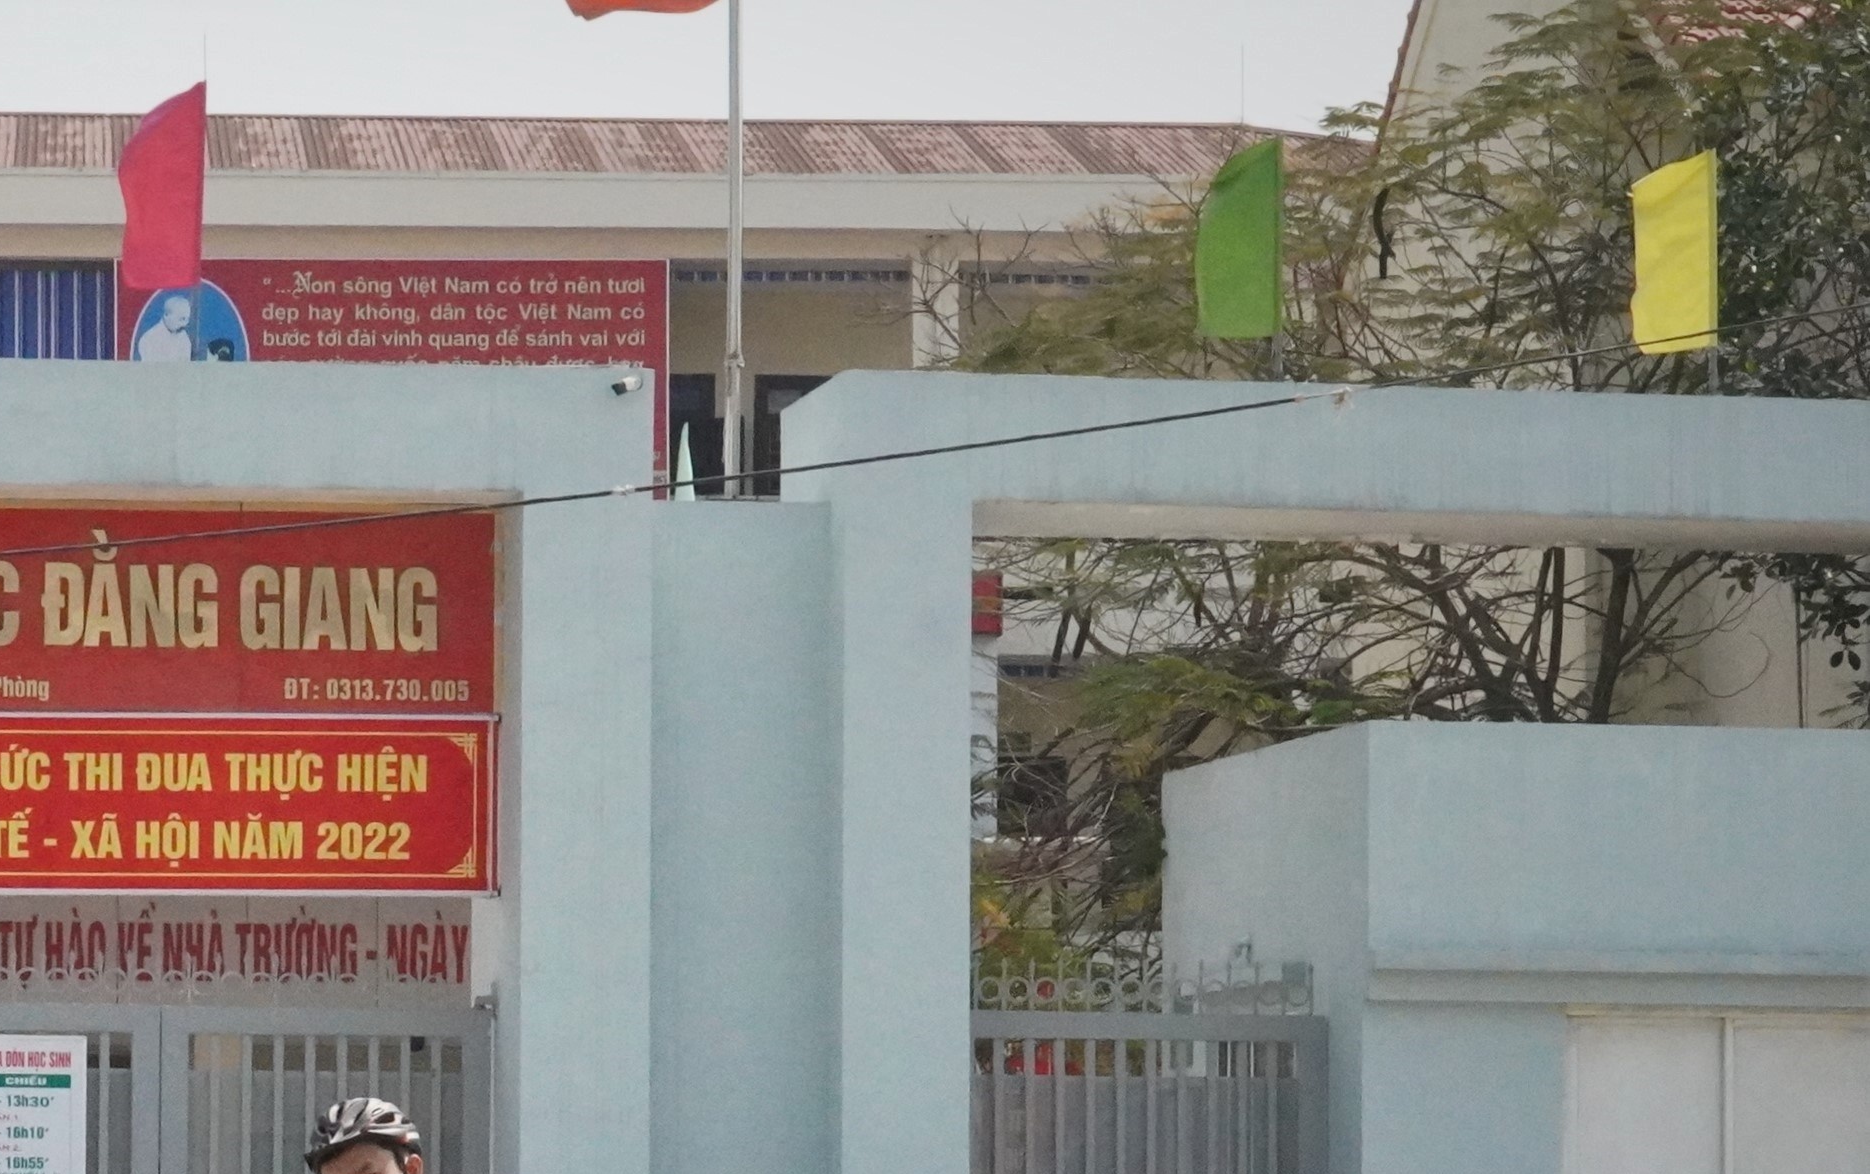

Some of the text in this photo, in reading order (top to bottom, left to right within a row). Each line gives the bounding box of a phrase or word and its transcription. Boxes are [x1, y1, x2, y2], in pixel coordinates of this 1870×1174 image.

[343, 276, 392, 298] sông
[399, 276, 437, 298] Việt
[445, 277, 489, 294] Nam
[496, 277, 522, 294] có
[530, 273, 558, 294] trở
[564, 276, 601, 294] nên
[607, 277, 646, 294] tươi
[262, 302, 645, 325] đẹp hay không, dân tộc Việt Nam có
[263, 324, 646, 350] bước tới đài vinh quang để sánh vai với
[41, 528, 219, 650] ĐẰNG
[240, 566, 439, 653] GIANG
[283, 677, 470, 702] ĐT: 0313.730.005
[64, 753, 123, 792] THI
[136, 753, 213, 792] ĐUA
[225, 749, 324, 801] THỰC
[337, 745, 429, 801] HIỆN
[44, 838, 57, 847] -
[72, 812, 123, 860] XÃ
[136, 812, 200, 869] HỘI
[214, 812, 304, 860] NĂM
[317, 821, 411, 861] 2022
[45, 907, 107, 981] HÀO
[234, 904, 358, 983] TRƯỜNG
[386, 909, 469, 984] NGÀY
[49, 1051, 72, 1068] SINH
